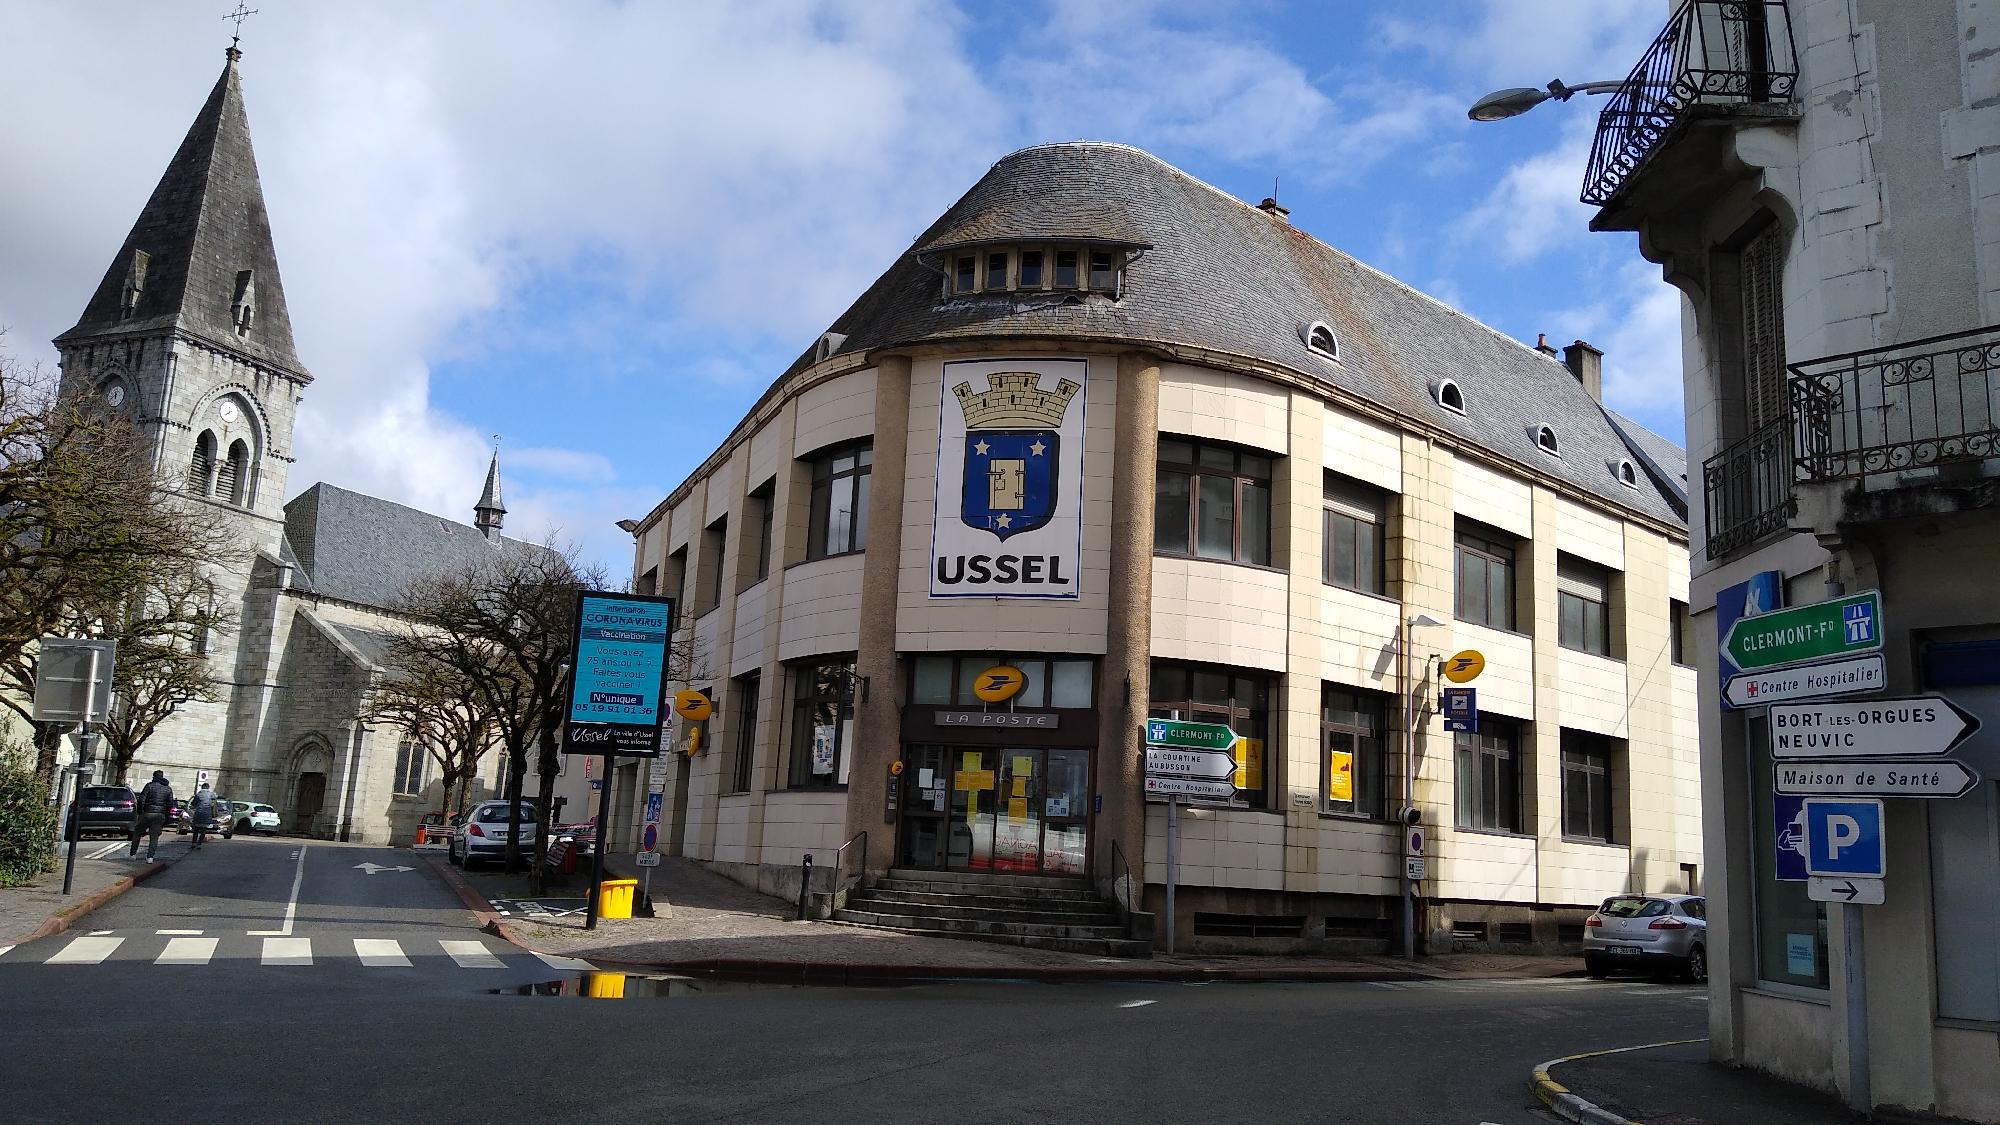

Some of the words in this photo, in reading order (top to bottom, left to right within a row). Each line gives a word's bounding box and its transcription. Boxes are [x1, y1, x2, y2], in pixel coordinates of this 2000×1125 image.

[938, 554, 1070, 584] USSEL
[587, 613, 662, 626] CORONAVIRUS
[601, 630, 646, 640] Vaccination
[597, 646, 619, 656] Vous
[622, 648, 644, 657] avez
[587, 656, 599, 665] 75
[593, 668, 621, 678] Faites
[624, 670, 646, 678] vous
[595, 680, 634, 688] vacciner
[1761, 680, 1798, 694] Centre
[1808, 667, 1879, 689] Hospitalier
[575, 704, 588, 712] 05
[592, 704, 605, 712] 19
[607, 705, 620, 713] 91
[640, 707, 652, 715] 36
[946, 714, 969, 724] LA
[982, 715, 1046, 725] POSTE
[572, 727, 611, 743] Ussel
[1778, 733, 1854, 748] NEUVIC
[630, 738, 652, 746] informe
[1162, 754, 1201, 762] COURTINE
[1149, 762, 1191, 771] AUBUSSON
[1784, 772, 1844, 785] Maison
[1856, 770, 1875, 786] de
[1886, 771, 1940, 786] Santé
[1158, 782, 1180, 790] Centre
[1186, 784, 1224, 793] Hospitalier
[1826, 814, 1860, 860] P
